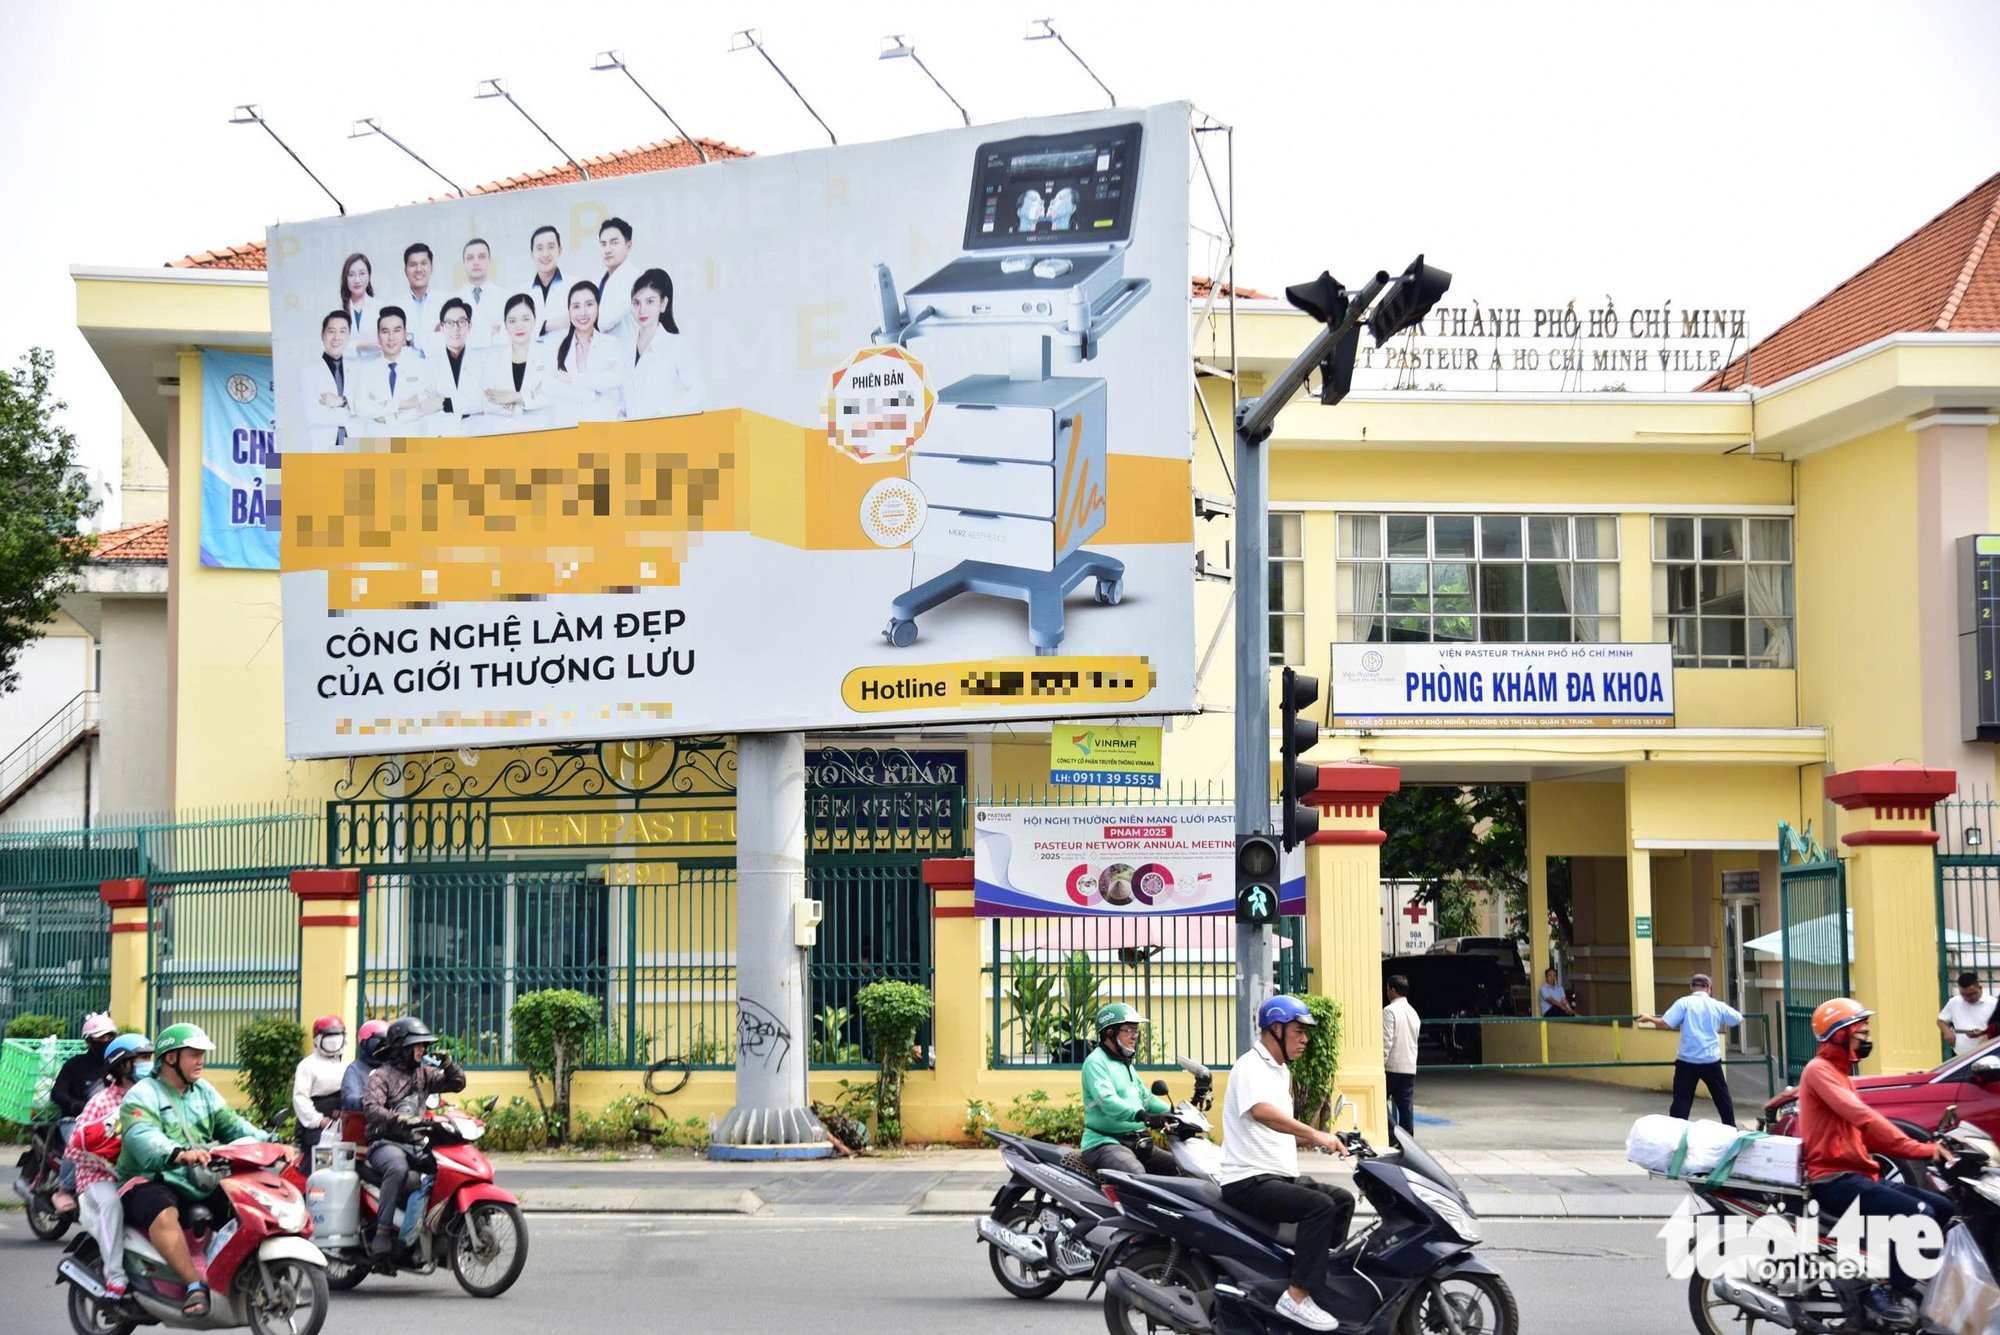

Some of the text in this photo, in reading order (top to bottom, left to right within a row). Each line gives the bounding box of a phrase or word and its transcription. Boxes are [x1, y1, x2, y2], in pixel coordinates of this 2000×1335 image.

[1435, 293, 1746, 338] THÀNH PHỐ HỒ CHÍ MINH
[1385, 347, 1479, 369] PASTEUR
[1513, 349, 1539, 370] HO
[1549, 348, 1584, 371] CHI
[1592, 350, 1648, 371] MINH
[1656, 350, 1722, 371] VILLE
[852, 369, 904, 389] PHIÊN BẢN
[1982, 579, 1990, 590] 1
[1982, 608, 1991, 618] 2
[326, 609, 686, 659] CÔNG NGHỆ LÀM ĐẸP
[1439, 649, 1462, 658] VIỆN
[1465, 649, 1508, 657] PASTEUR
[1511, 647, 1545, 657] THÀNH
[1547, 647, 1568, 657] PHỐ
[1588, 647, 1606, 657] CHÍ
[1608, 649, 1633, 658] MINH
[317, 646, 695, 699] CỦA GIỚI THƯỢNG LƯU
[1984, 669, 1992, 680] 3
[861, 678, 946, 700] Hotline
[1405, 664, 1664, 703] PHÒNG KHÁM ĐA KHOA
[1094, 739, 1137, 748] VINAMA
[1055, 772, 1154, 785] LH: 0911 39 5555
[1023, 815, 1042, 826] HỘI
[1045, 816, 1070, 827] NGHỊ
[1074, 814, 1116, 825] THƯỜNG
[1120, 813, 1145, 824] NIÊN
[1147, 815, 1178, 825] MẠNG
[1181, 814, 1205, 824] LƯỚI
[1143, 828, 1167, 836] 2025
[1034, 842, 1082, 850] PASTEUR
[1086, 841, 1140, 850] NETWORK
[1144, 841, 1188, 849] ANNUAL
[601, 862, 666, 886] 1891
